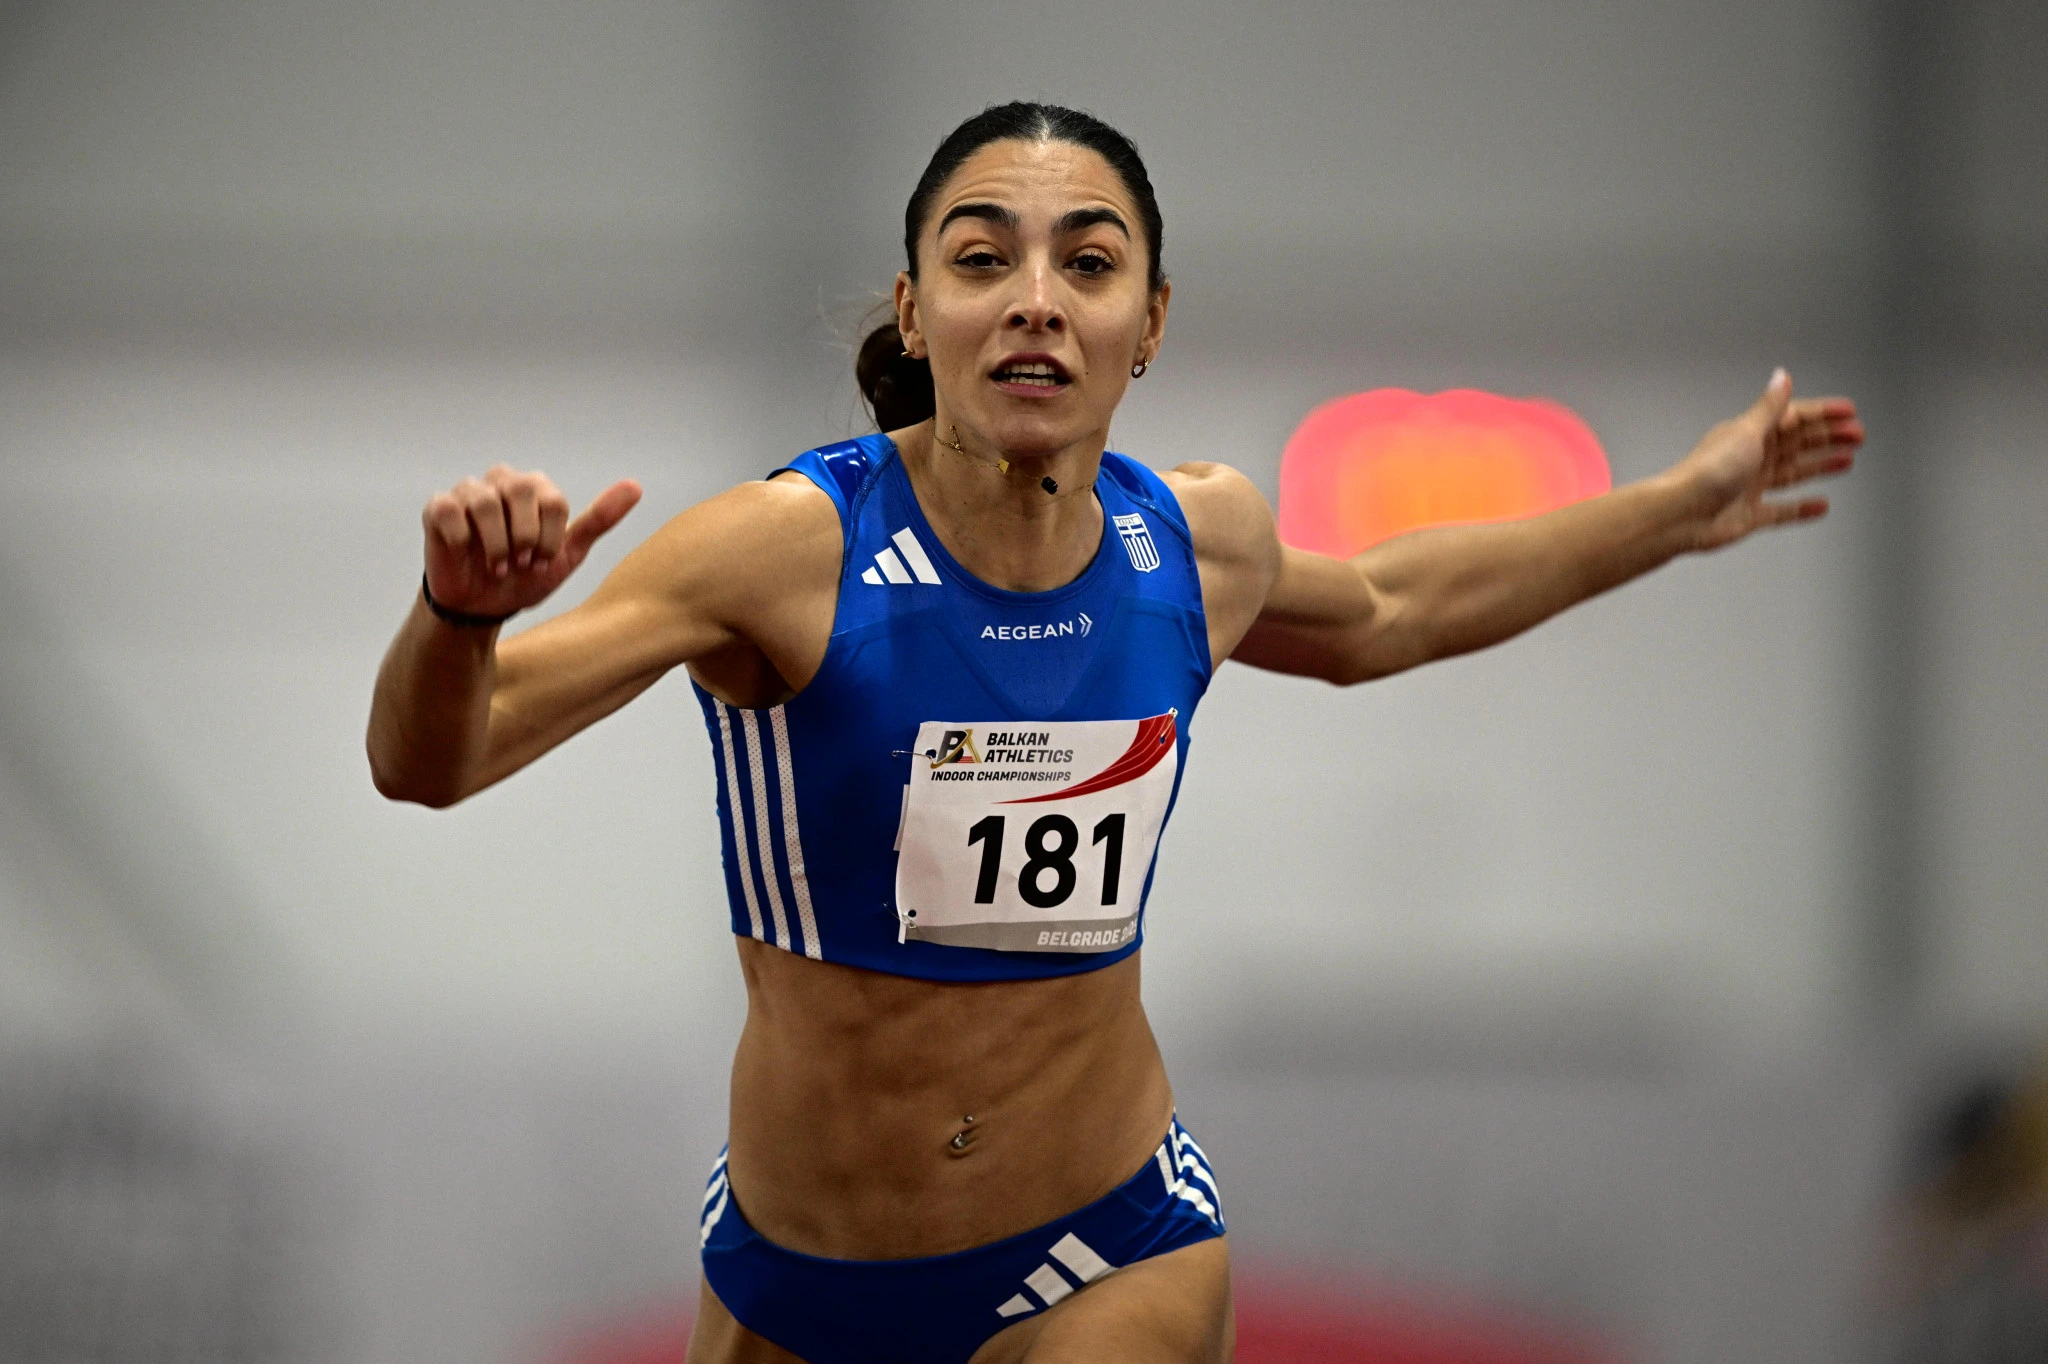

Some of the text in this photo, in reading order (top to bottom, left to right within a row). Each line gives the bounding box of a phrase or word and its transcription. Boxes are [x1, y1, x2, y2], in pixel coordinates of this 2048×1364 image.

[981, 620, 1074, 640] AEGEAN
[986, 732, 1050, 746] BALKAN
[983, 749, 1074, 763] ATHLETICS
[931, 771, 1071, 781] INDOOR CHAMPIONSHIPS
[967, 813, 1126, 908] 181
[1037, 929, 1121, 946] BELGRADE
